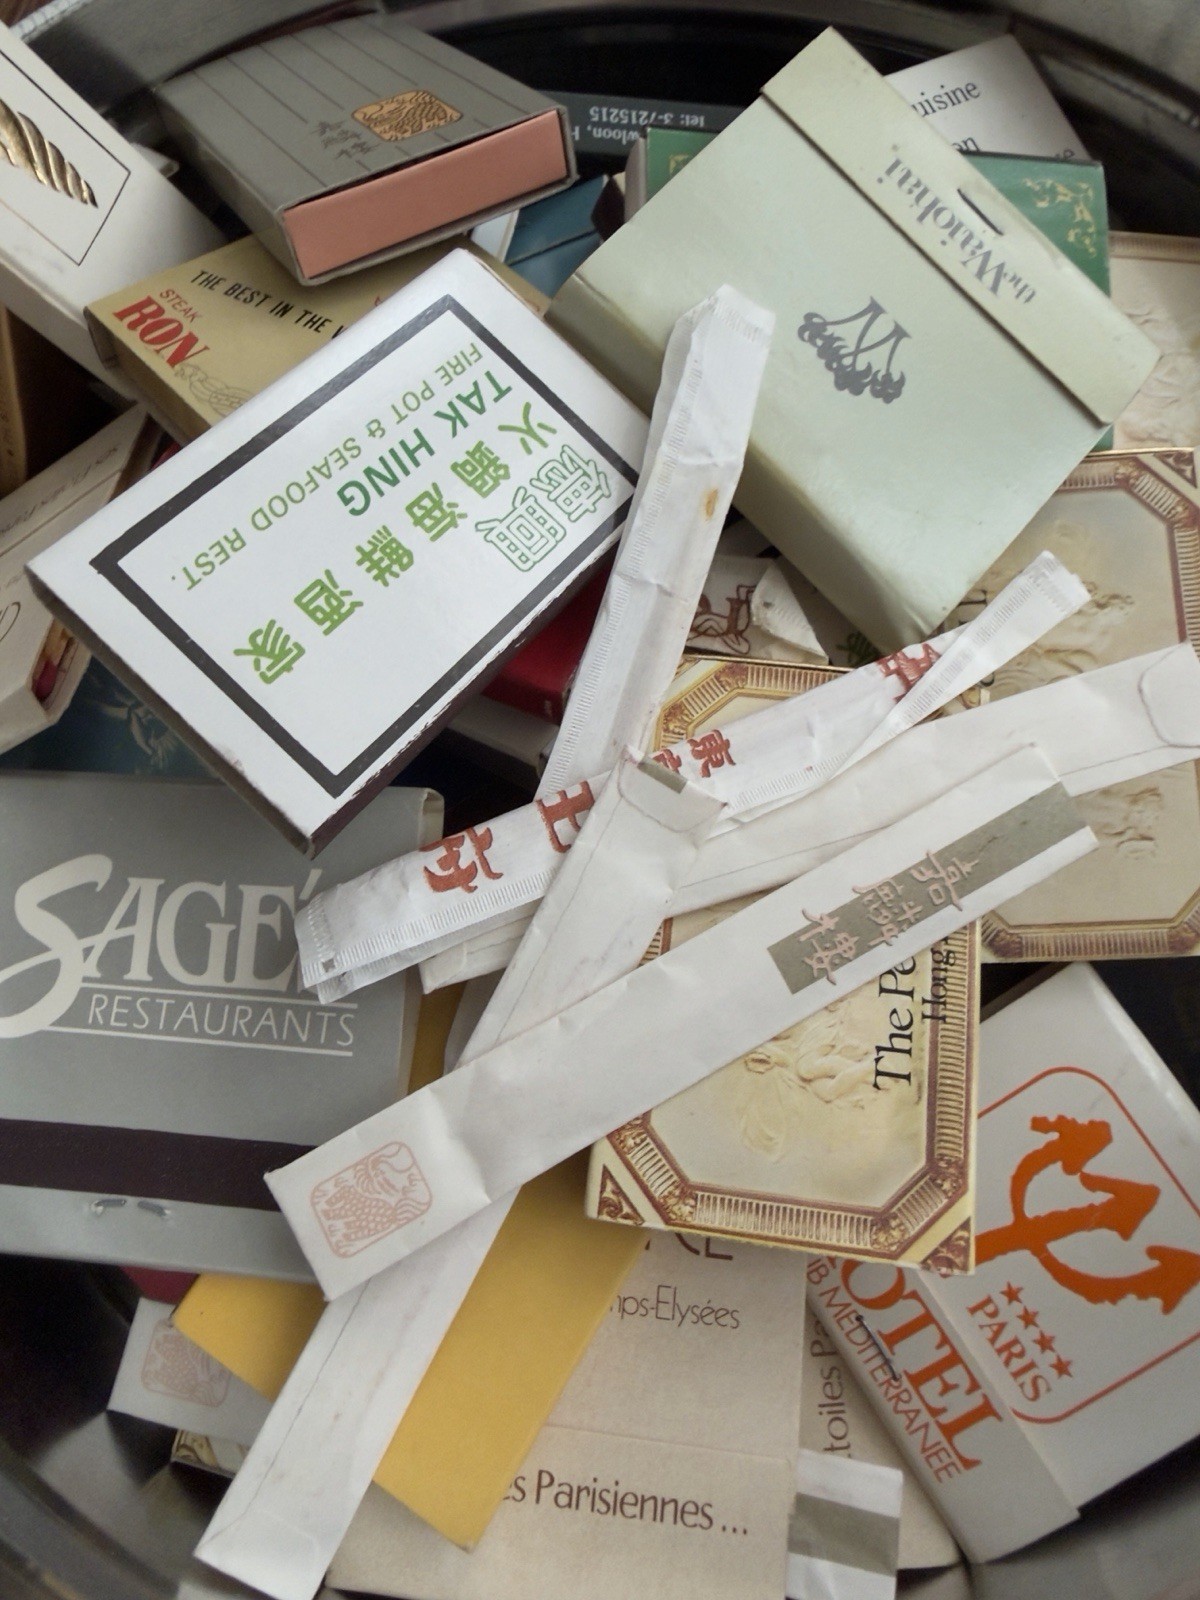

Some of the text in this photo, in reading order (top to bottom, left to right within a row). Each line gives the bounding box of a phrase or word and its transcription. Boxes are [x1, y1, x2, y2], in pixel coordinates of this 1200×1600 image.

[877, 158, 1006, 297] Waiohai
[111, 294, 211, 369] RON
[159, 287, 204, 324] STEAK
[190, 270, 223, 291] THE
[224, 284, 273, 308] BEST
[269, 300, 292, 319] IN
[294, 309, 333, 334] THE
[170, 343, 484, 592] FIRE POT & SEAFOOD REST.
[335, 370, 513, 517] TAK HING
[233, 402, 558, 685] 火鍋海鮮酒家
[474, 443, 615, 573] 德興
[87, 993, 355, 1047] RESTAURANTS
[921, 947, 956, 1023] Hong
[872, 1007, 915, 1091] The
[819, 1285, 962, 1484] MEDITERRANEE
[828, 1255, 1002, 1472] OTEL
[966, 1294, 1052, 1402] PARIS
